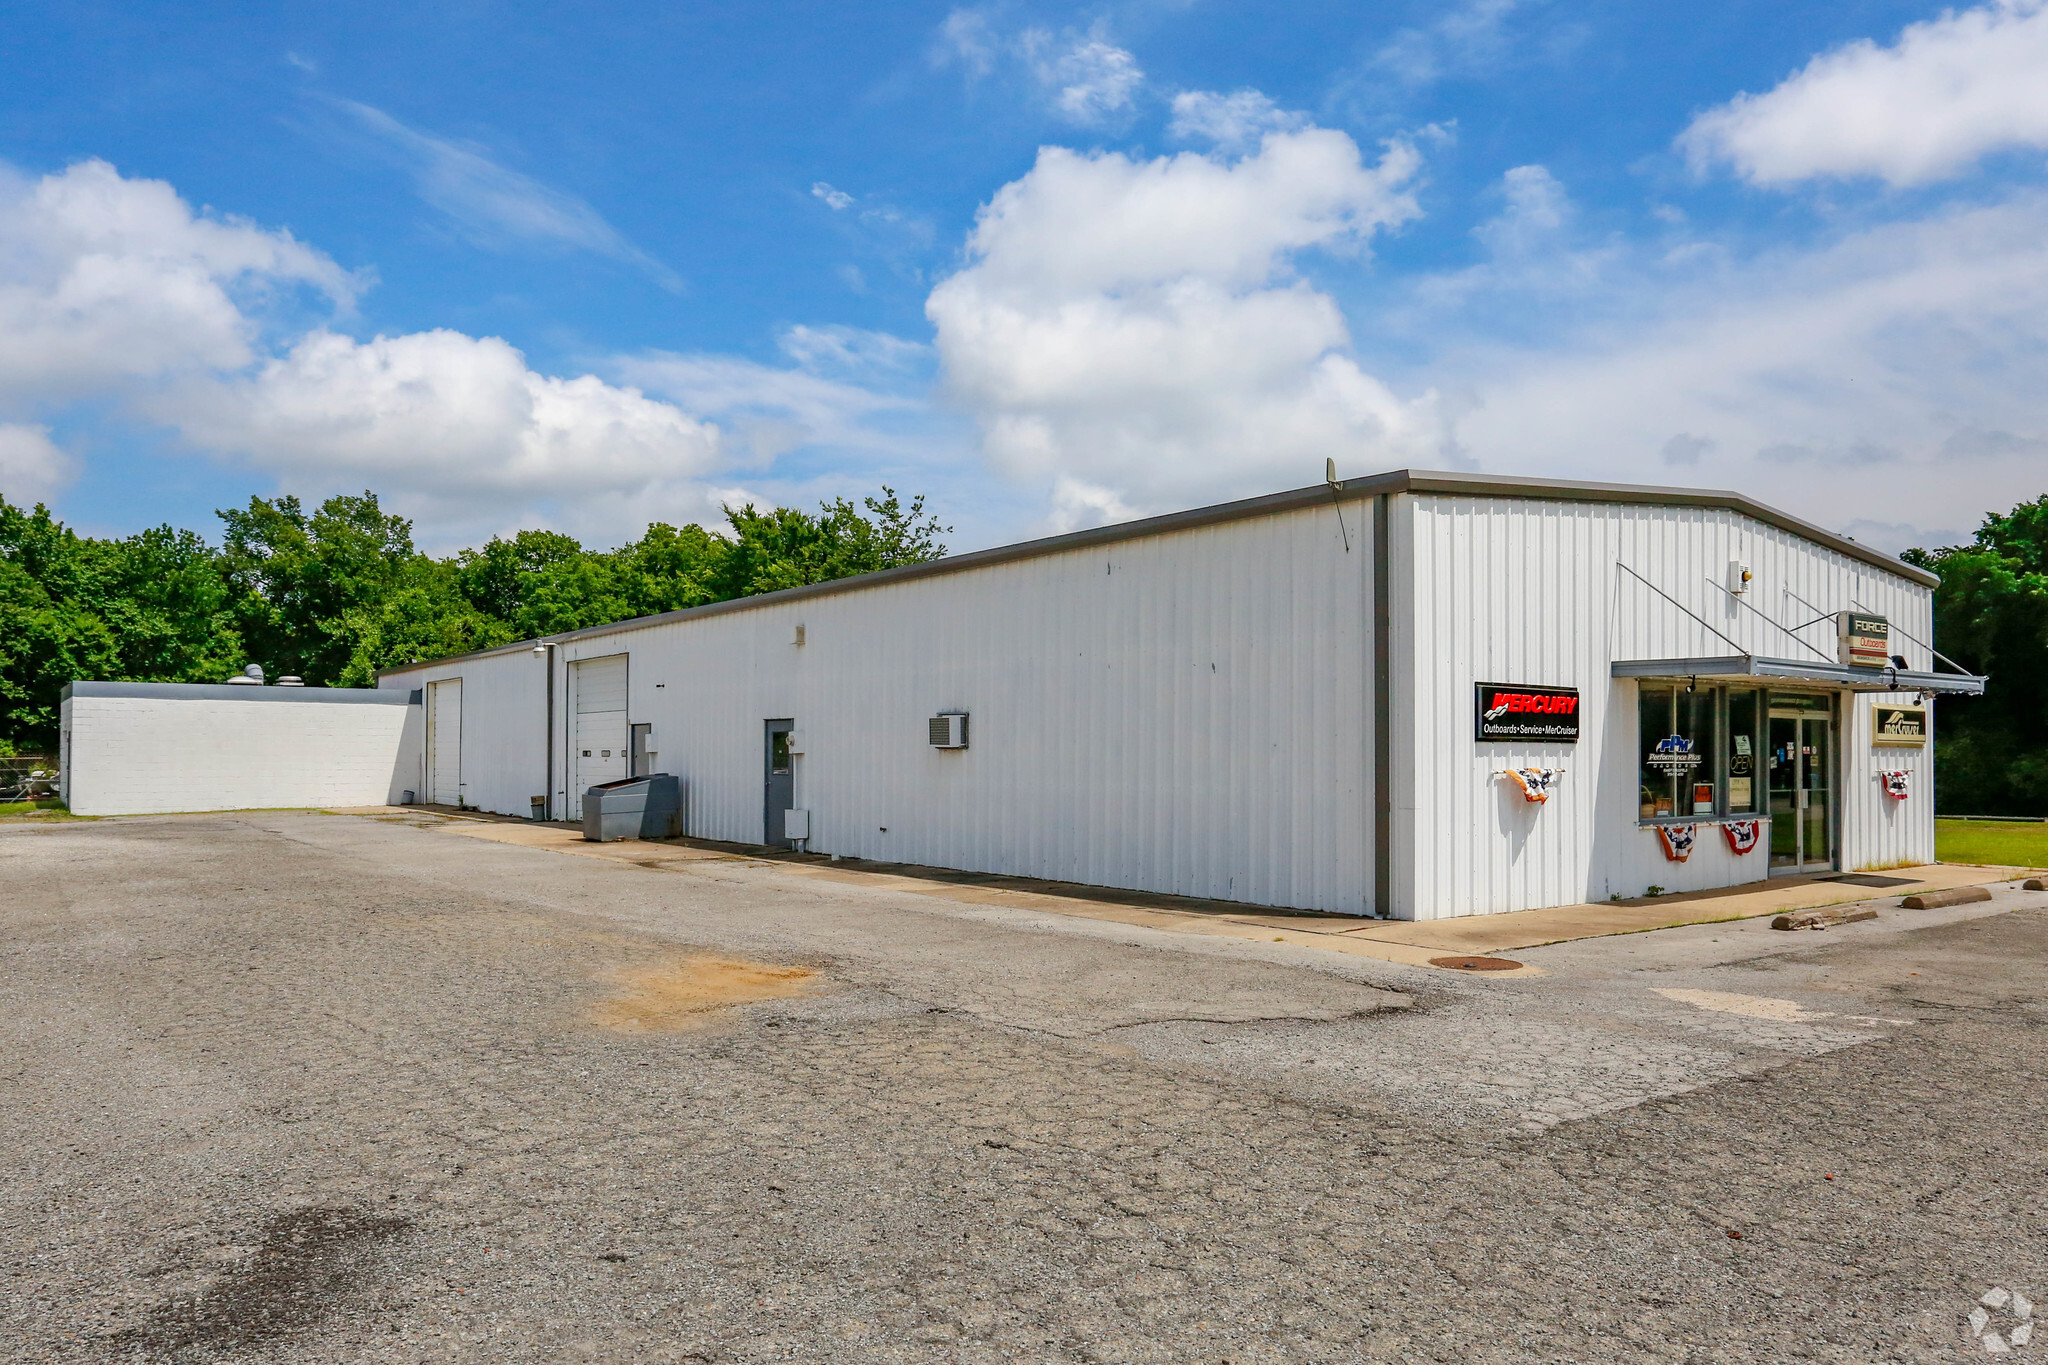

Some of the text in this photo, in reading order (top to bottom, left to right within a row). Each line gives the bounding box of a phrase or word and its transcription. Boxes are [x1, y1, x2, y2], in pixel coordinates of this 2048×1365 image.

[1855, 620, 1887, 633] FORCE
[1860, 637, 1886, 648] Outboards
[1491, 693, 1578, 714] MERCURY
[1660, 734, 1690, 752] PPM
[1648, 753, 1687, 761] Performnce
[1730, 756, 1753, 770] OPEN
